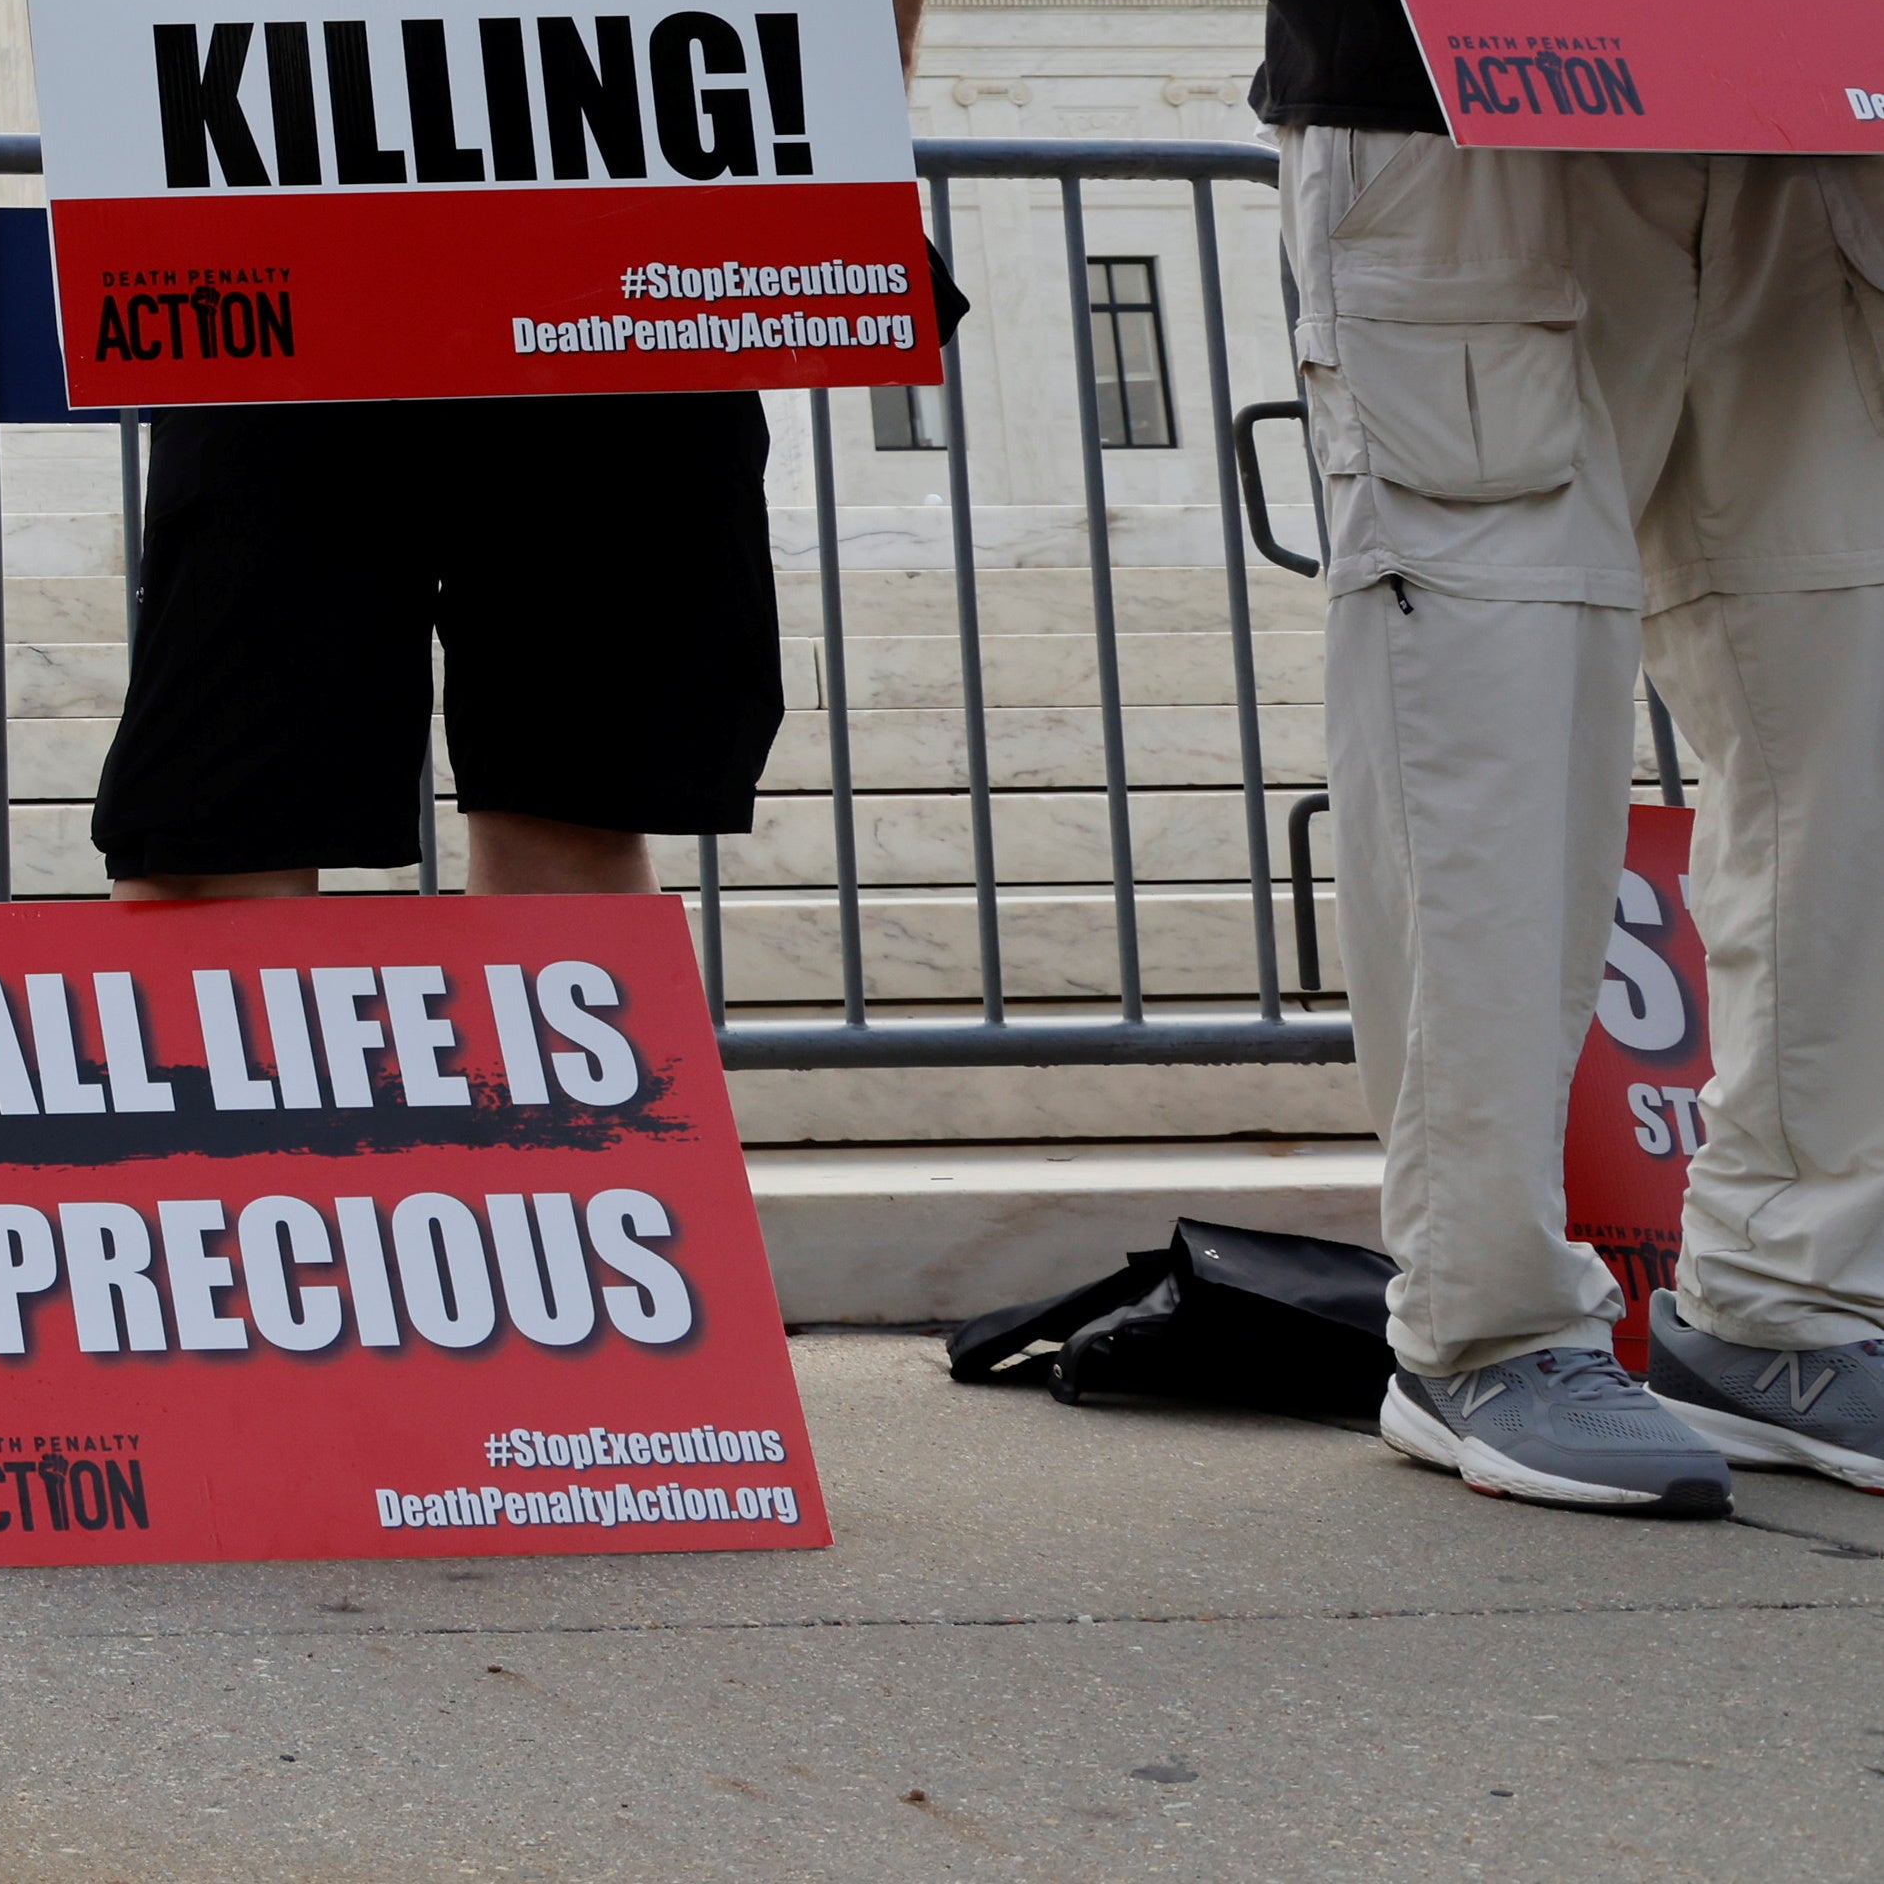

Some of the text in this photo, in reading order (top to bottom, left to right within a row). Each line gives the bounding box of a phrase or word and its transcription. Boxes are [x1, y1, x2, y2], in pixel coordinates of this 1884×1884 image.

[1447, 35, 1622, 51] DEATH PENALTY
[152, 10, 815, 189] KILLING!
[1454, 52, 1645, 115] ACTION
[102, 267, 291, 287] DEATH PENALTY
[620, 259, 909, 302] #StopExecutions
[95, 287, 296, 362] ACTION
[512, 311, 915, 354] DeathPenaltyAction.org
[192, 965, 470, 1112] LIFE
[483, 960, 640, 1108] IS
[1573, 1222, 1627, 1239] DEATH
[34, 1434, 140, 1453] PENALTY
[484, 1424, 786, 1470] #StopExecutions
[375, 1482, 800, 1528] DeathPenaltyAction.org
